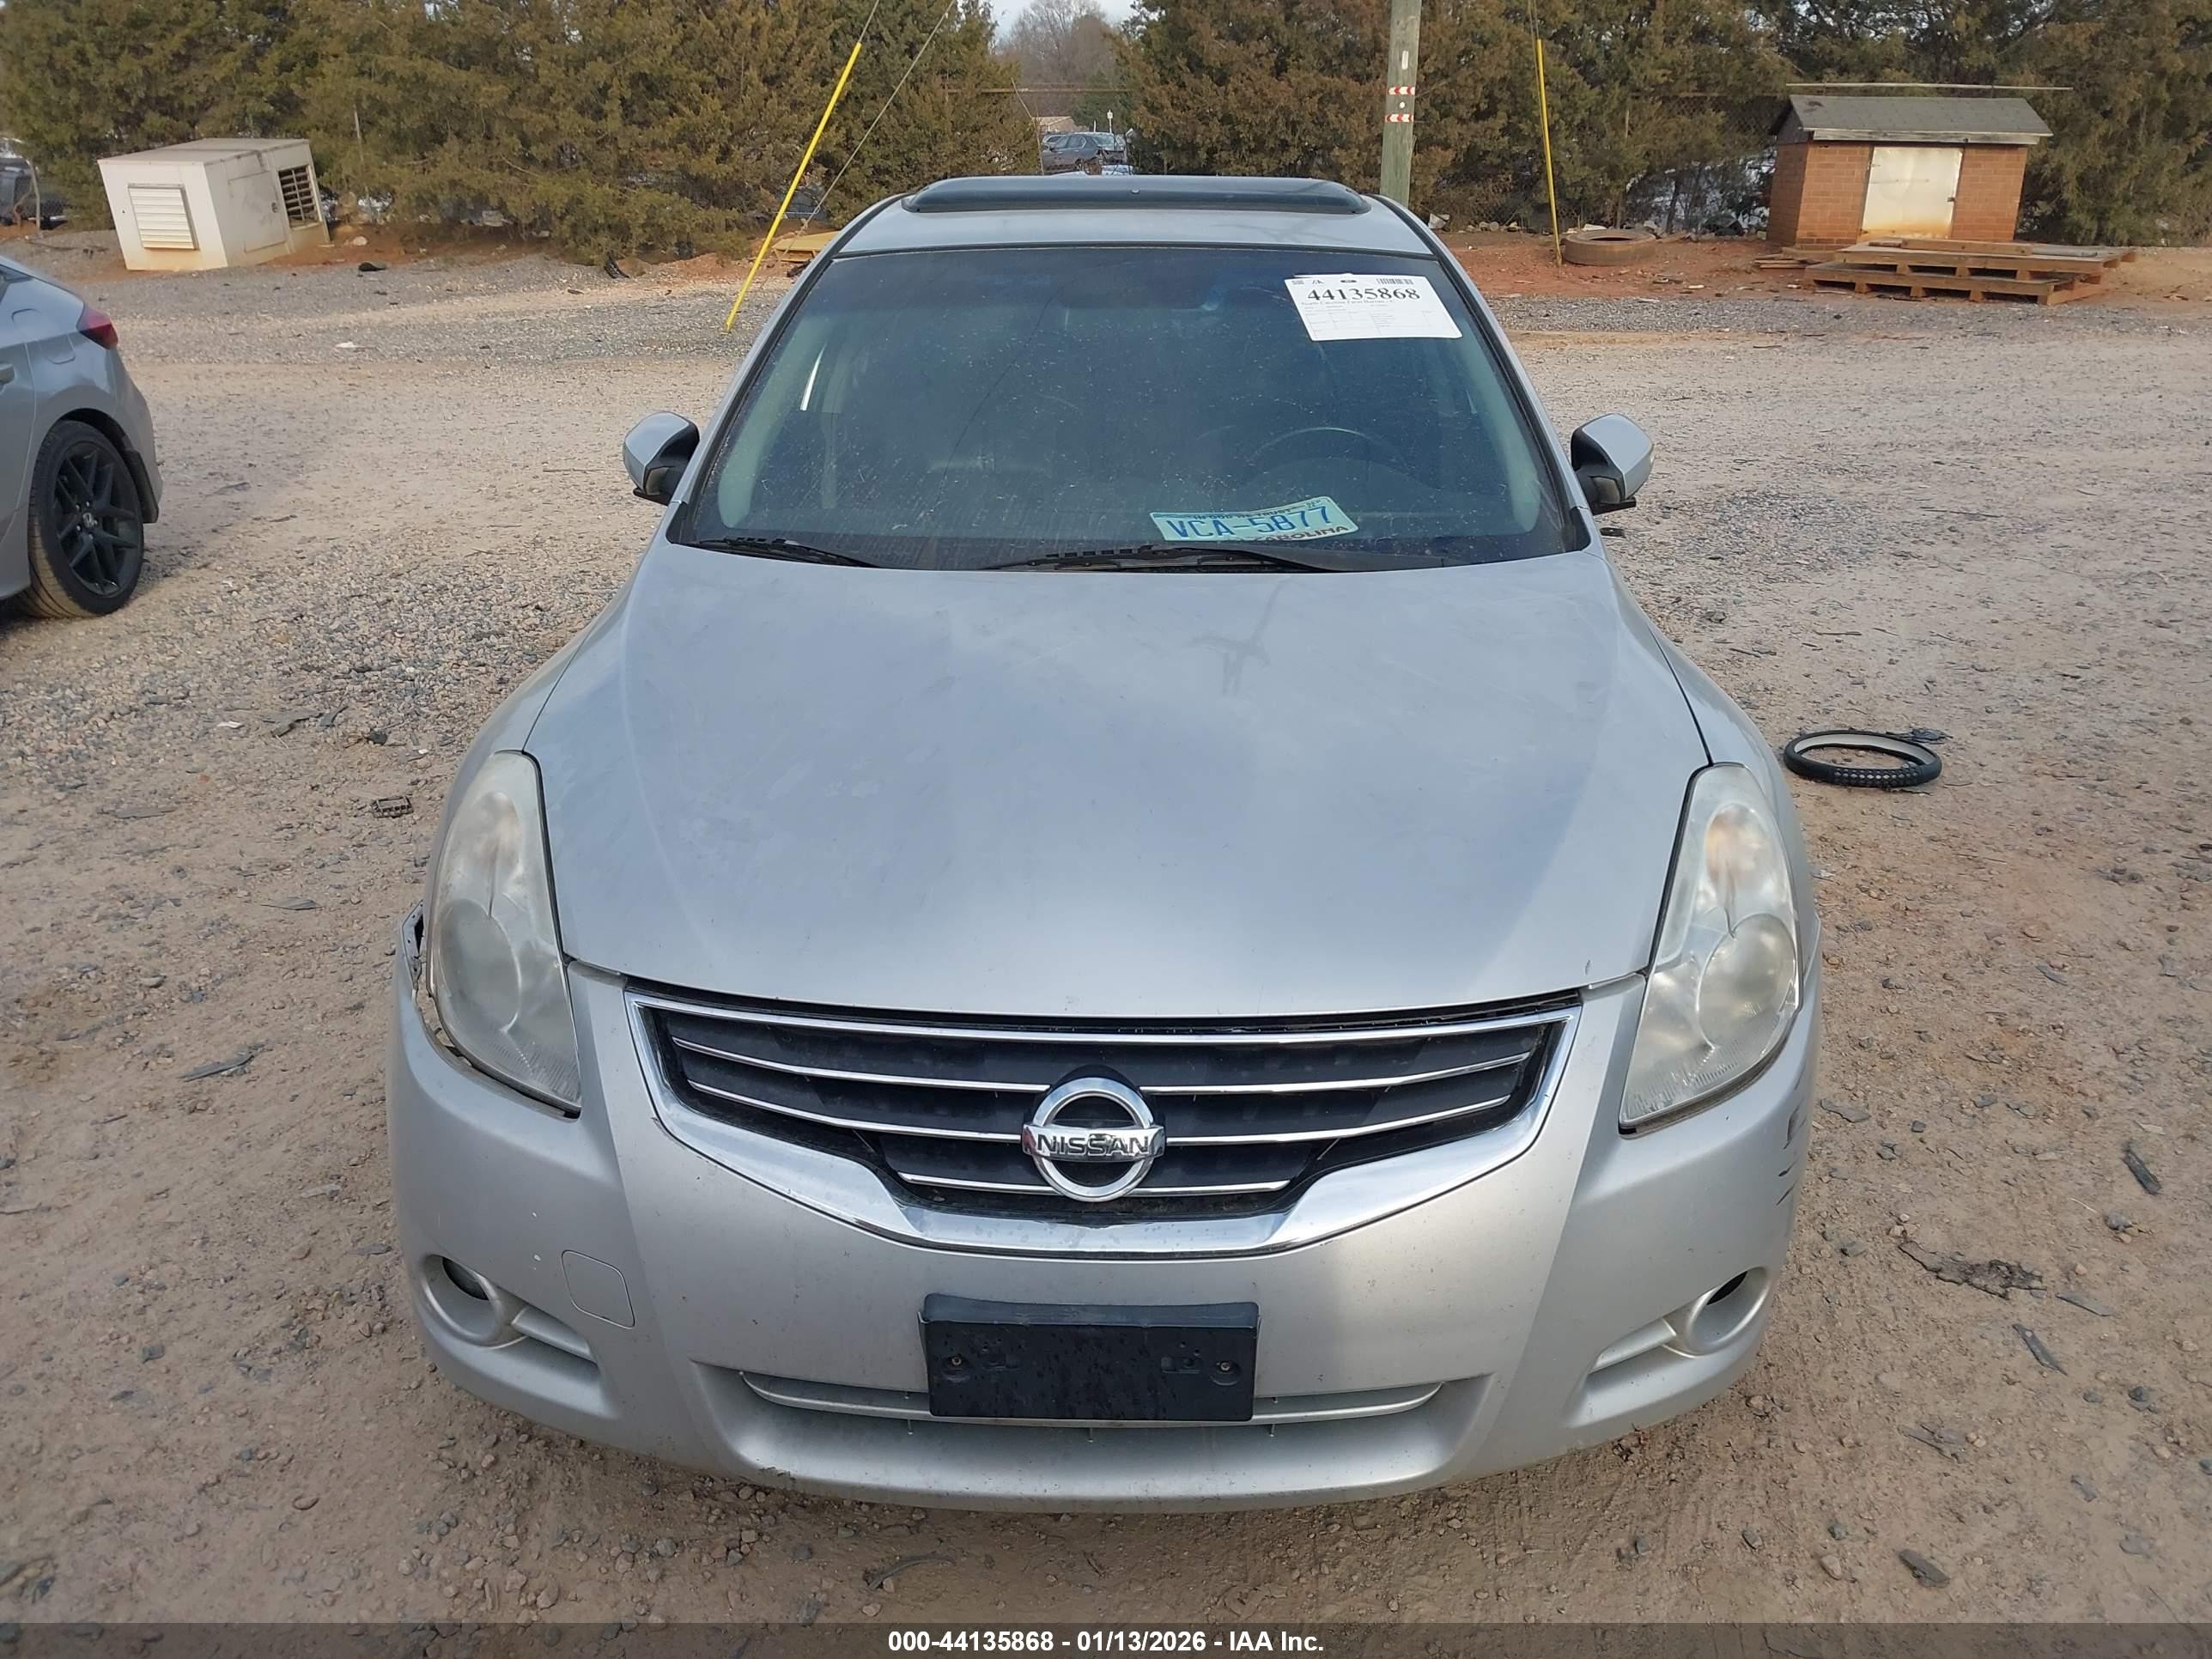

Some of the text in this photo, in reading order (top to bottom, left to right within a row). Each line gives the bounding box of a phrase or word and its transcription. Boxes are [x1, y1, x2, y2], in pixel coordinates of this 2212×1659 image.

[1307, 287, 1421, 301] 44135868
[1167, 505, 1331, 538] VCA-5877
[1037, 1133, 1150, 1157] NISSAN
